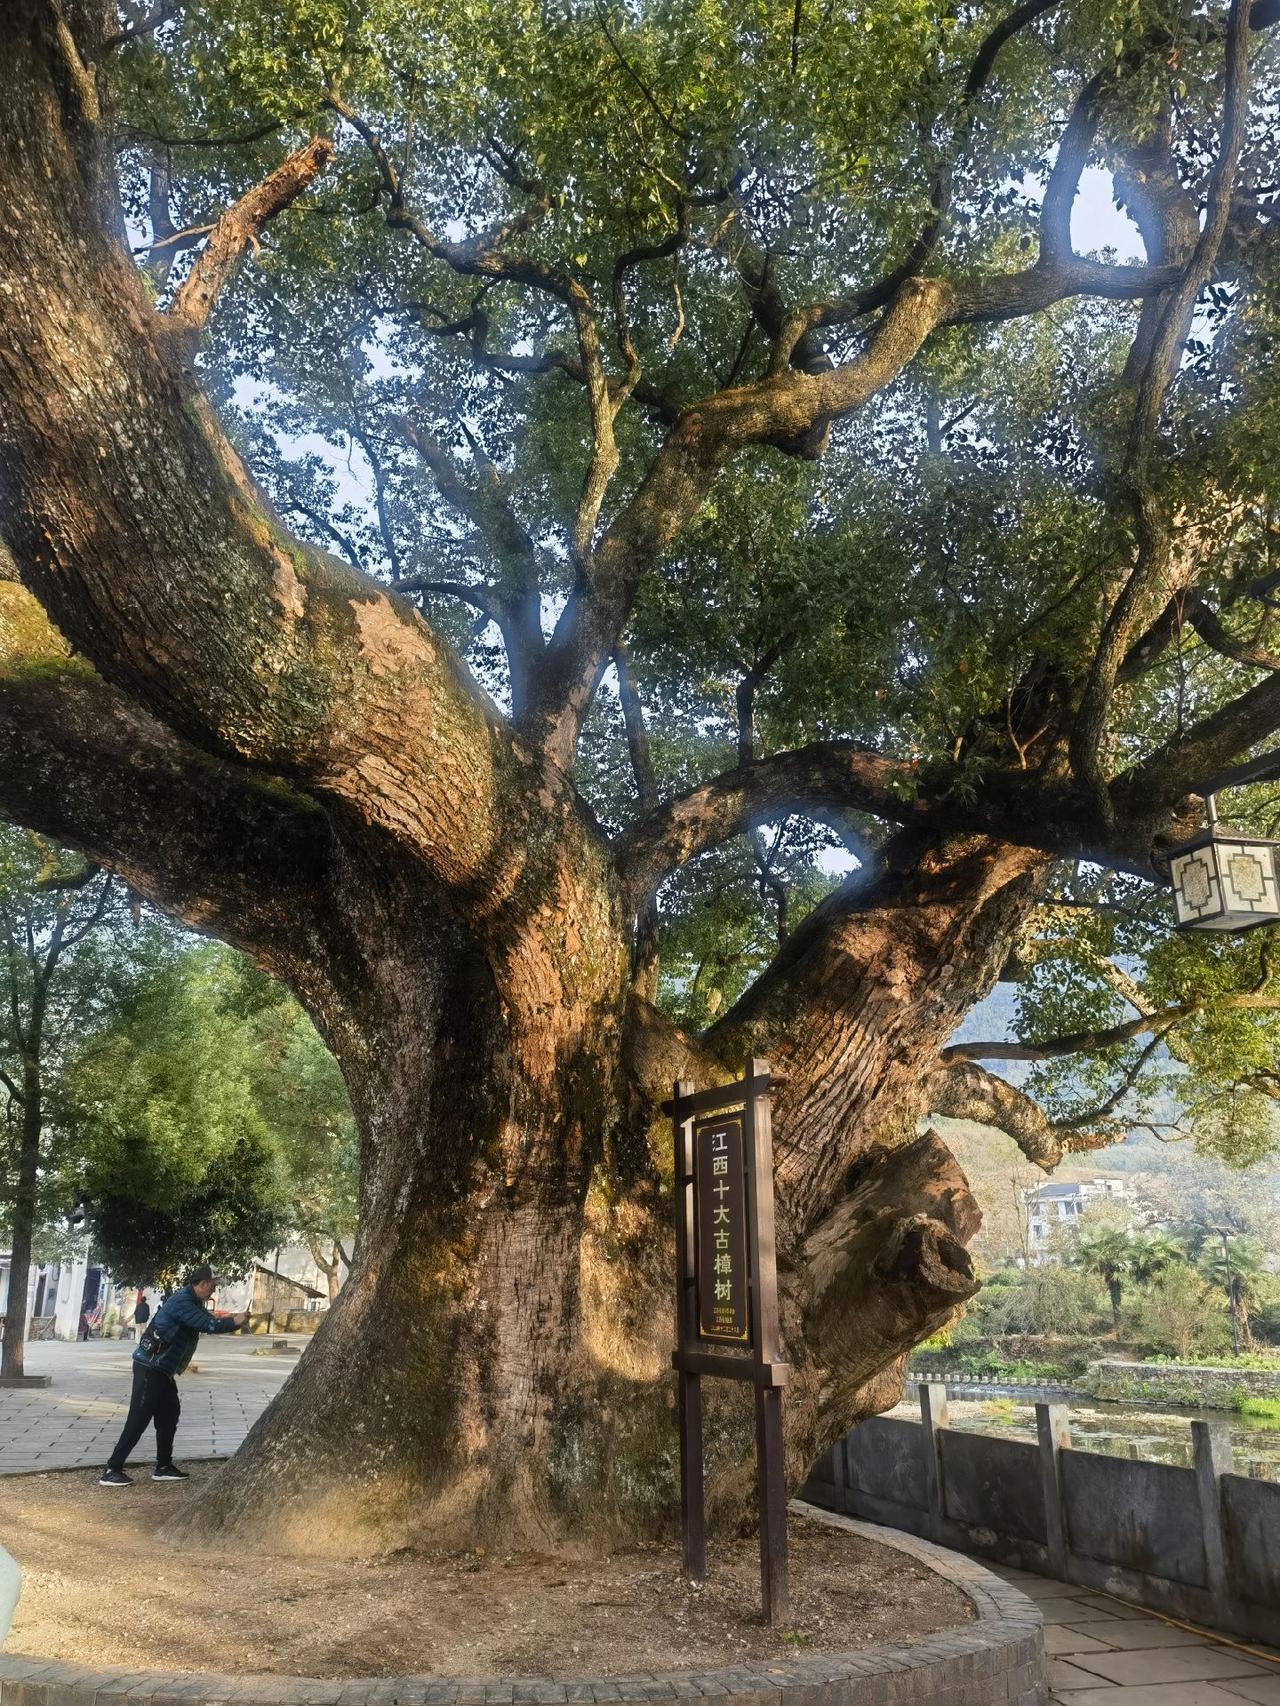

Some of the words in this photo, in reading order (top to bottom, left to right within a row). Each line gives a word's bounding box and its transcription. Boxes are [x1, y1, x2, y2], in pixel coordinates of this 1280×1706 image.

[712, 1132, 733, 1301] 江西十大古樟树
